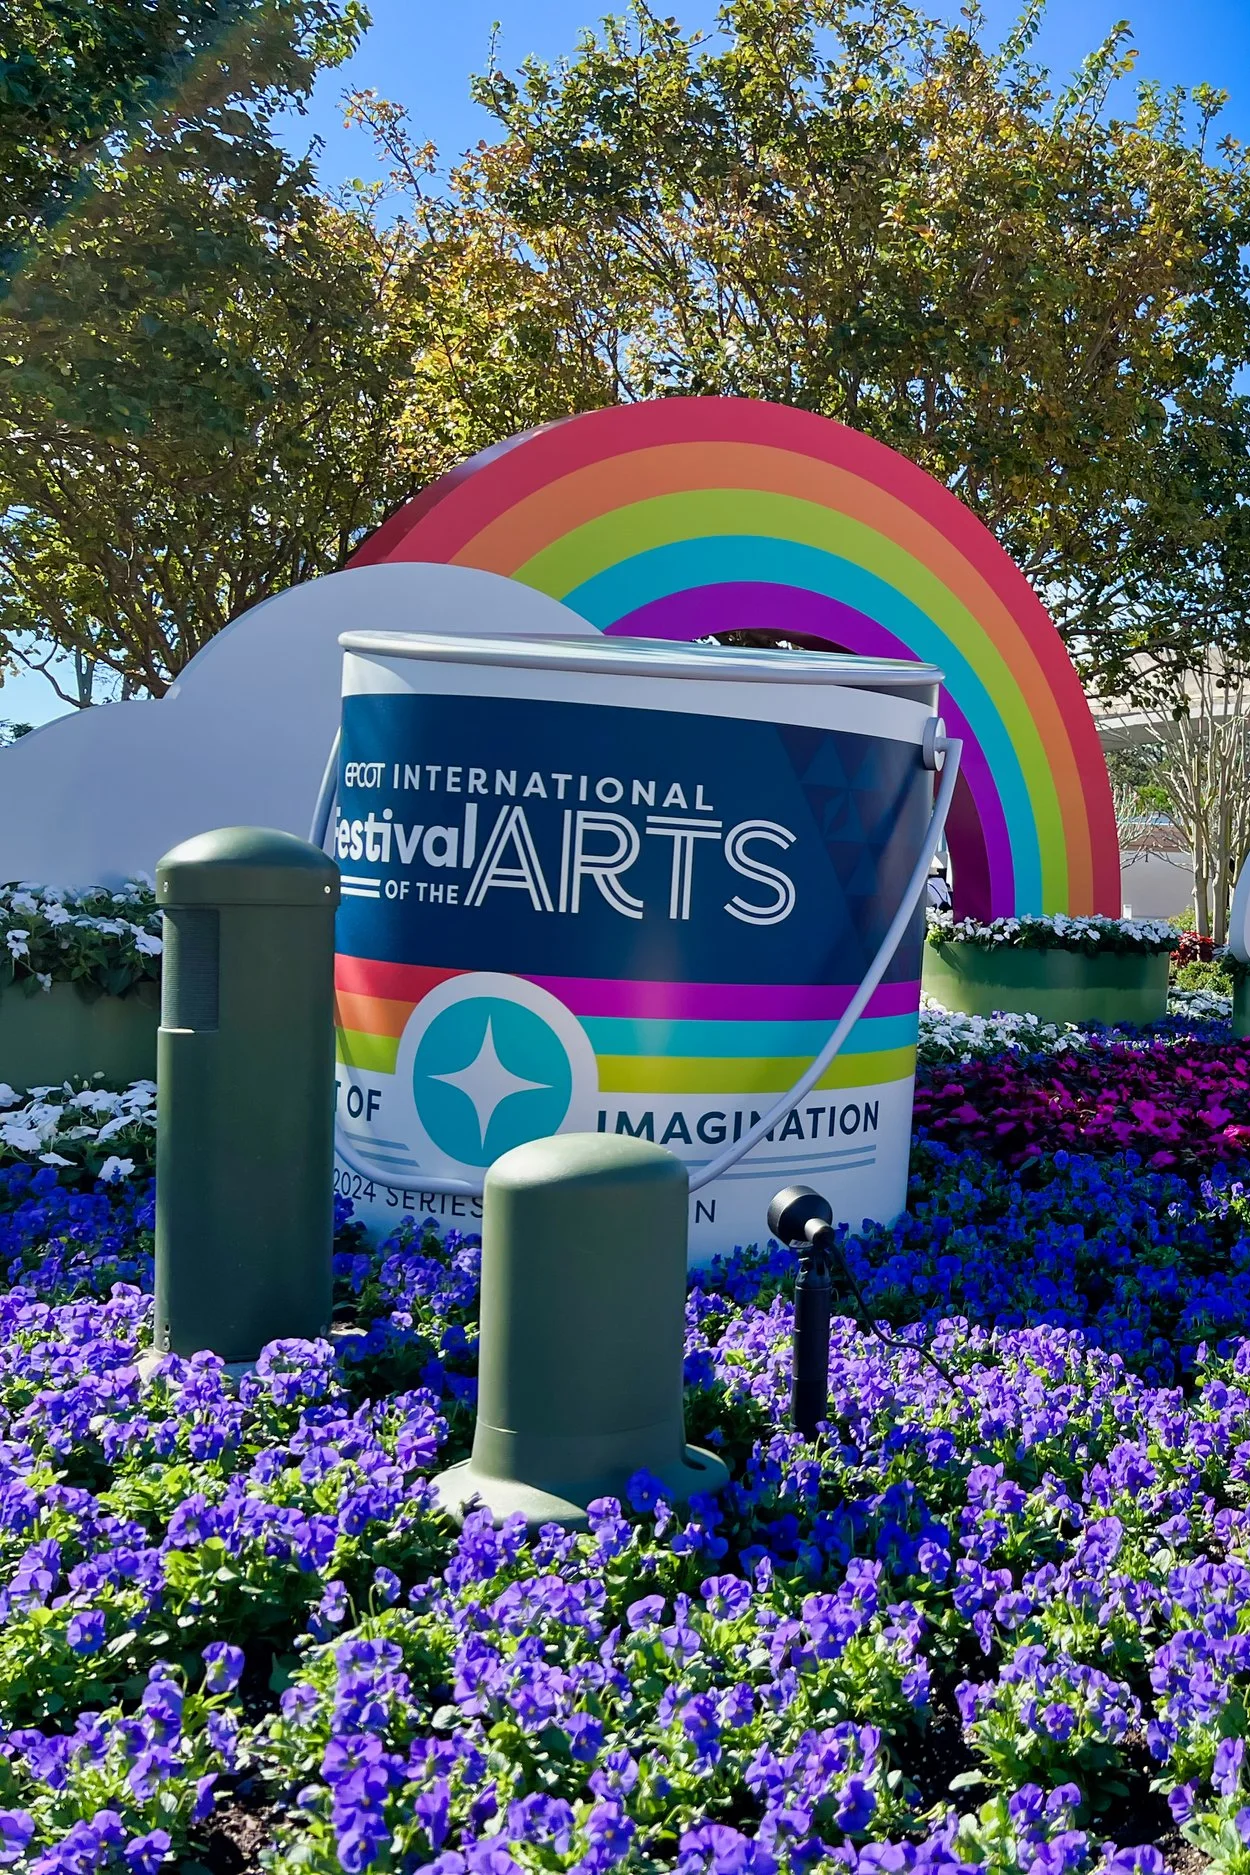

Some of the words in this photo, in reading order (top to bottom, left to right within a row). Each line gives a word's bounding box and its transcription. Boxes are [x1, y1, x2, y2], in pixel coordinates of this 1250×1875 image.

[345, 762, 386, 788] EPCOT
[393, 763, 715, 811] INTERNATIONAL
[464, 804, 798, 926] ARTS
[384, 879, 410, 900] OF
[416, 882, 459, 905] THE
[347, 1085, 382, 1122] OF
[334, 1168, 377, 1203] 2024
